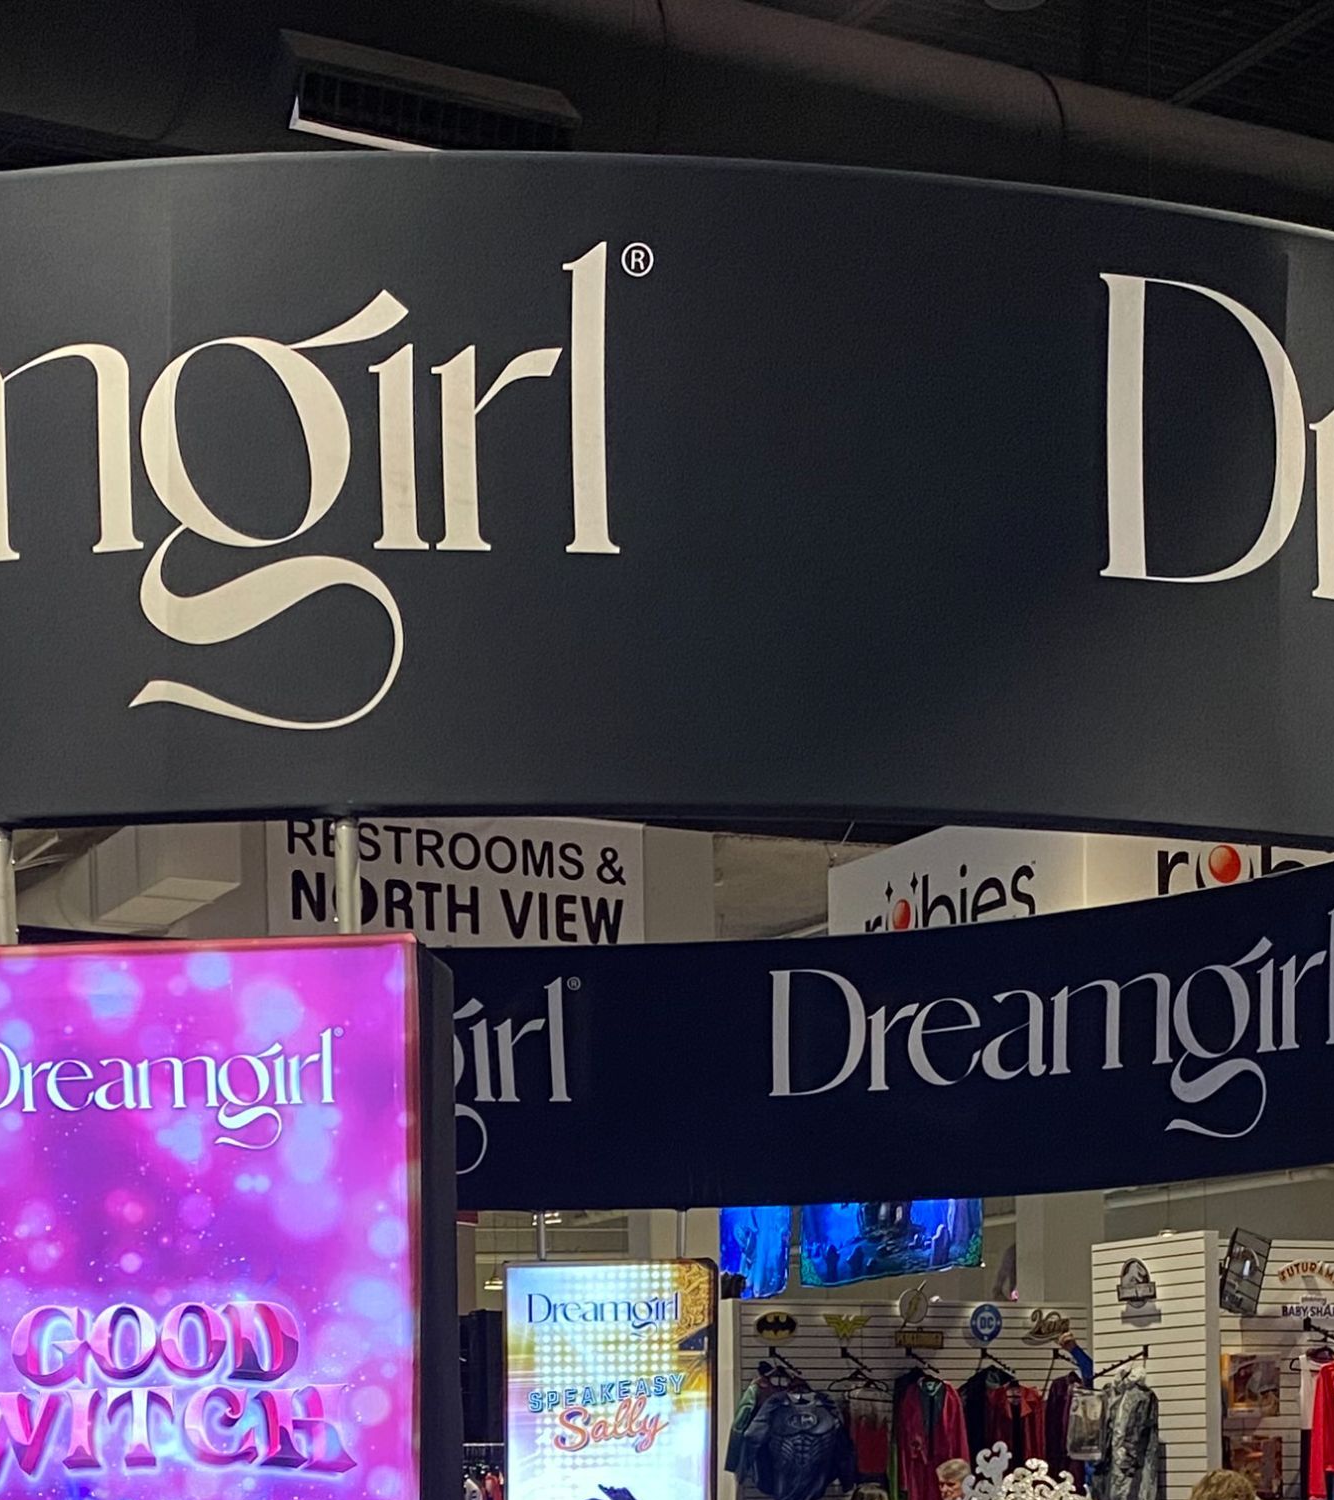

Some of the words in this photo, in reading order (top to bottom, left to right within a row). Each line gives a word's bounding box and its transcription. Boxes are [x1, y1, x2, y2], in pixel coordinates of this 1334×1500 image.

[596, 846, 627, 886] &
[500, 888, 624, 944] VIEW
[527, 1291, 682, 1339] Dreamgirl
[1281, 1305, 1308, 1317] BABY
[10, 1302, 301, 1387] GOOD
[528, 1371, 686, 1413] SPEAKEASY
[553, 1395, 669, 1453] Sally
